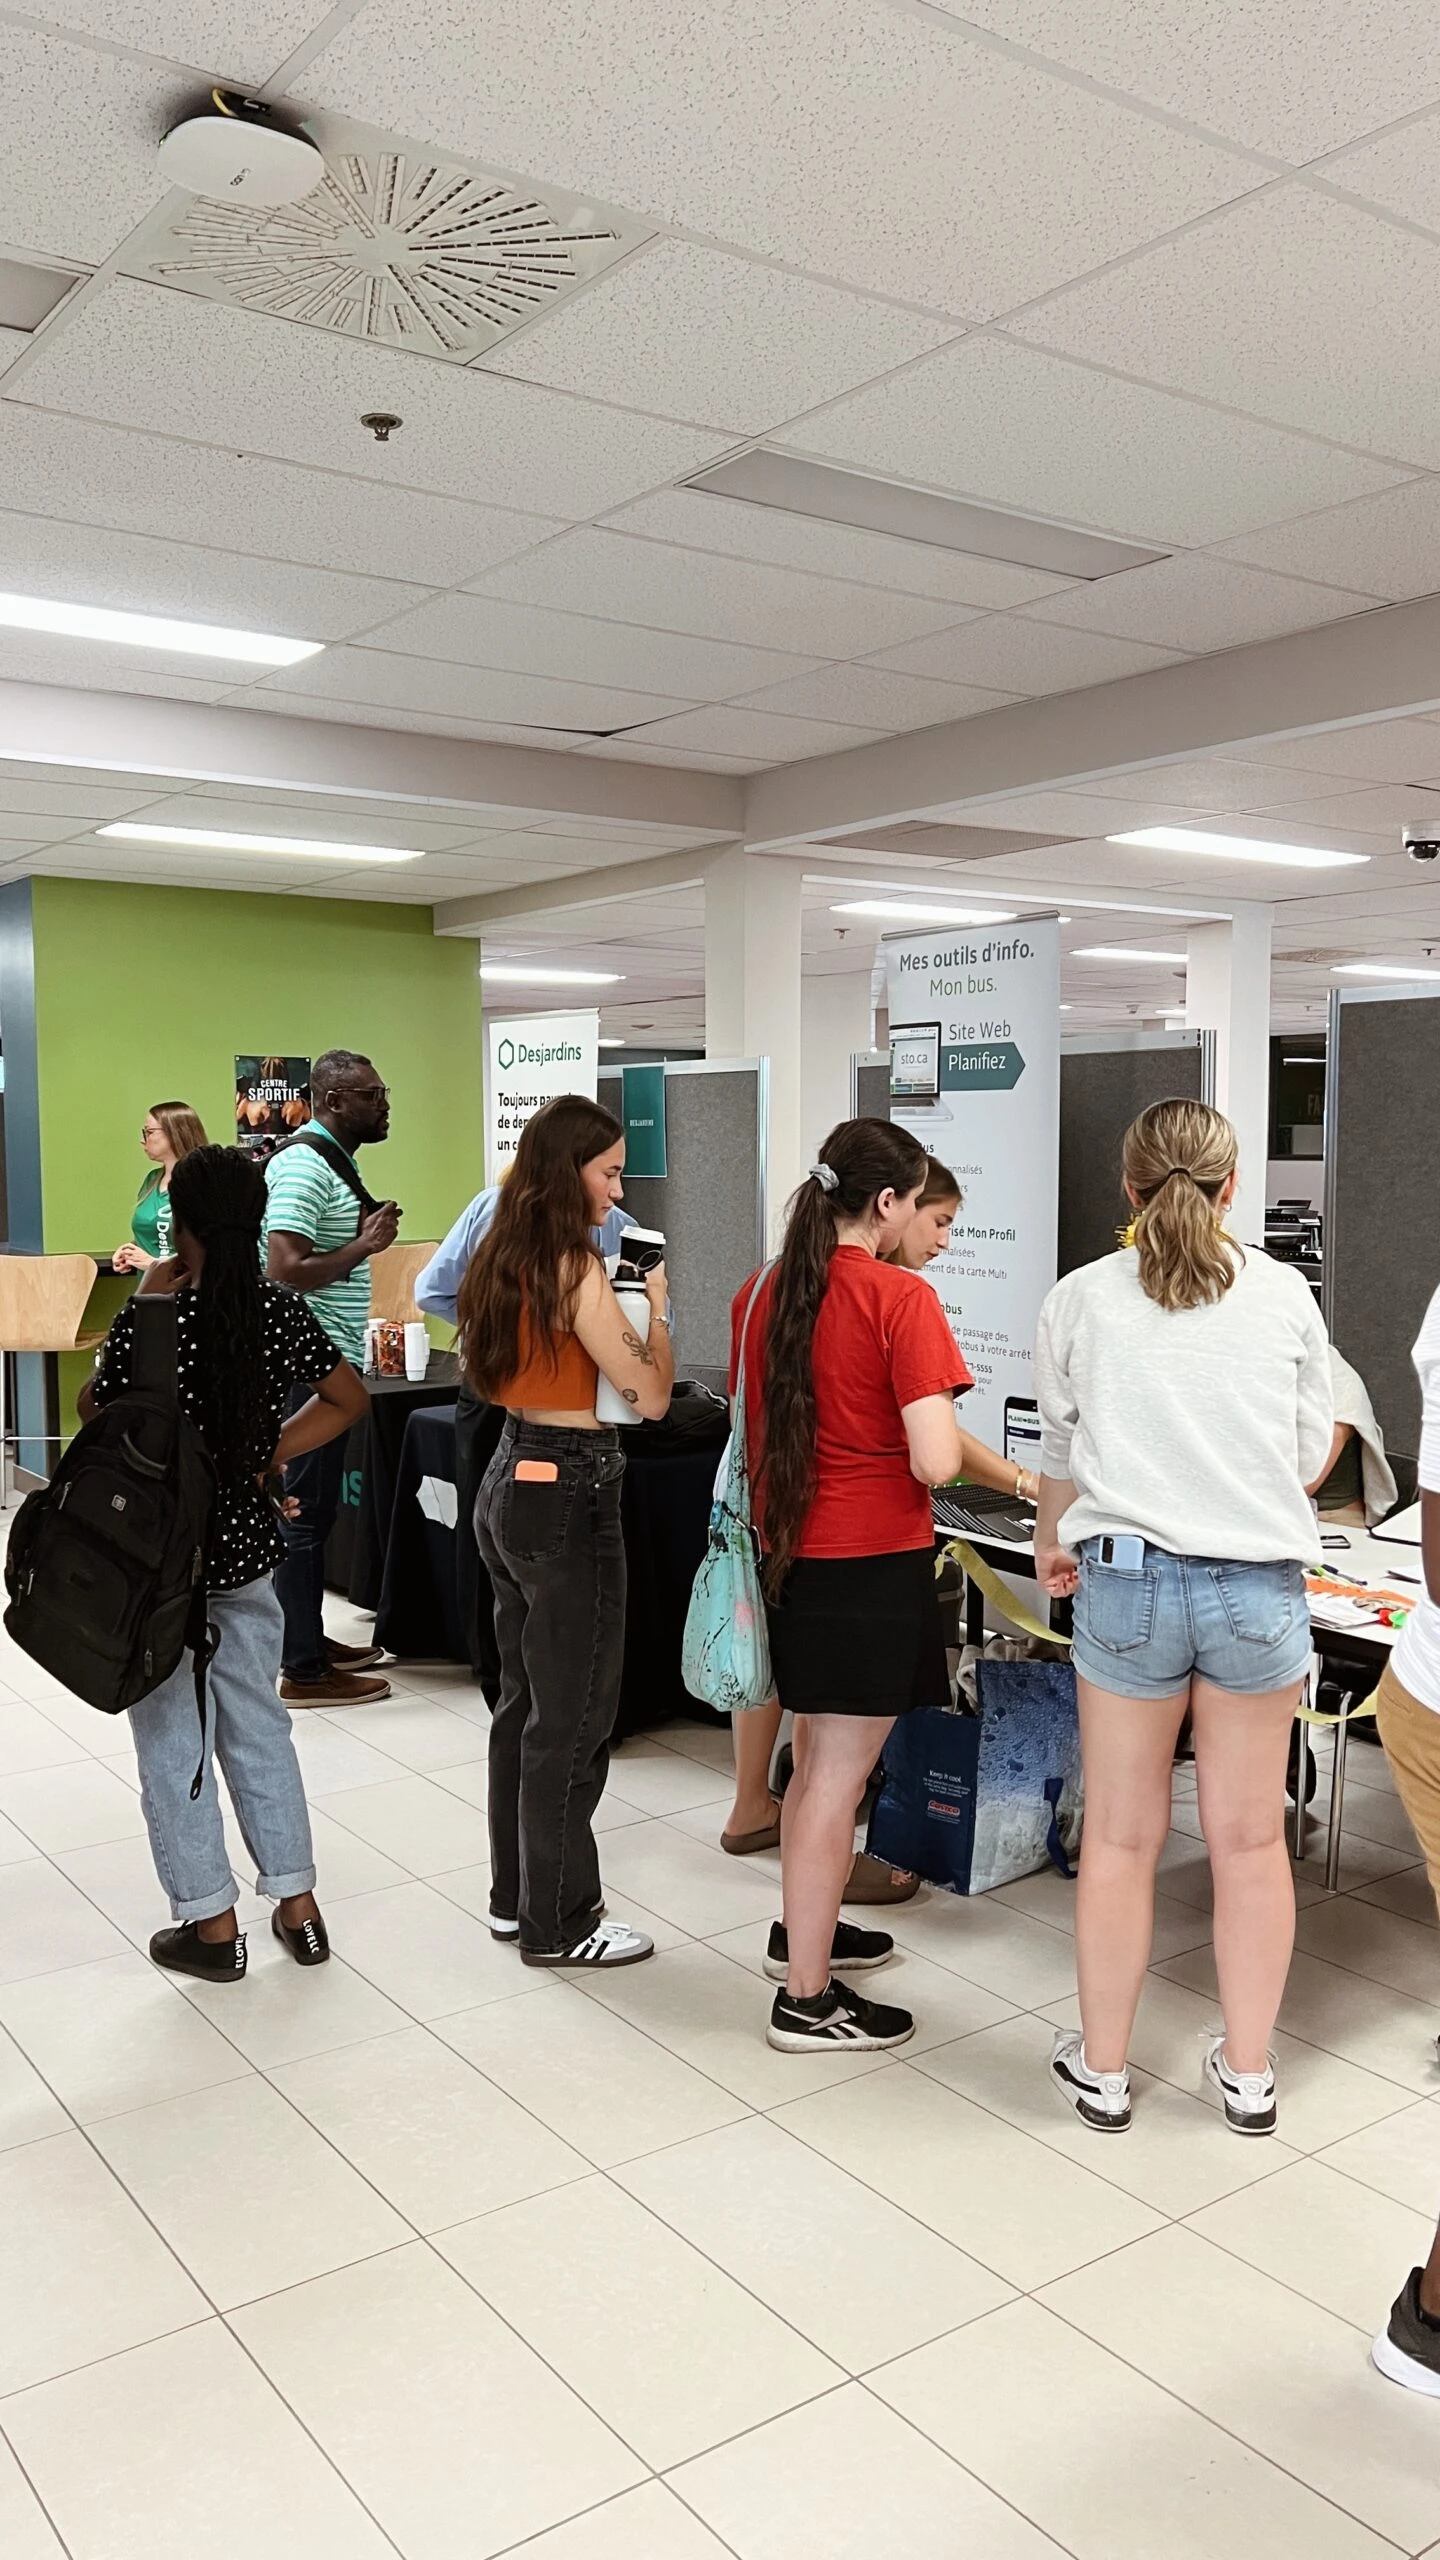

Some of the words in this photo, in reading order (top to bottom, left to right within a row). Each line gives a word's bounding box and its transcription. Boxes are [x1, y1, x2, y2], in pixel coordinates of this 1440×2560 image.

[900, 953, 928, 972] Mes
[933, 945, 977, 969] outils
[982, 939, 1034, 962] d'info.
[930, 979, 962, 997] Mon
[968, 975, 997, 994] bus.
[949, 1023, 975, 1041] Site
[980, 1019, 1011, 1038] Web
[518, 1041, 582, 1066] Desjardins
[901, 1053, 928, 1065] sto.ca
[948, 1051, 1006, 1072] Planifiez
[260, 1079, 288, 1088] CENTRE
[248, 1088, 300, 1101] SPORTIF
[498, 1092, 538, 1110] Toujours
[498, 1114, 510, 1129] de
[497, 1140, 510, 1151] un
[967, 1227, 987, 1239] Mon
[989, 1228, 1016, 1241] Profil
[946, 1264, 956, 1274] de
[957, 1265, 965, 1275] la
[966, 1267, 987, 1279] carte
[951, 1325, 961, 1335] de
[963, 1327, 993, 1342] passage
[995, 1331, 1009, 1342] des
[980, 1341, 985, 1353] à
[987, 1346, 1007, 1357] votre
[1009, 1348, 1031, 1360] arrêt
[978, 1376, 992, 1385] pour
